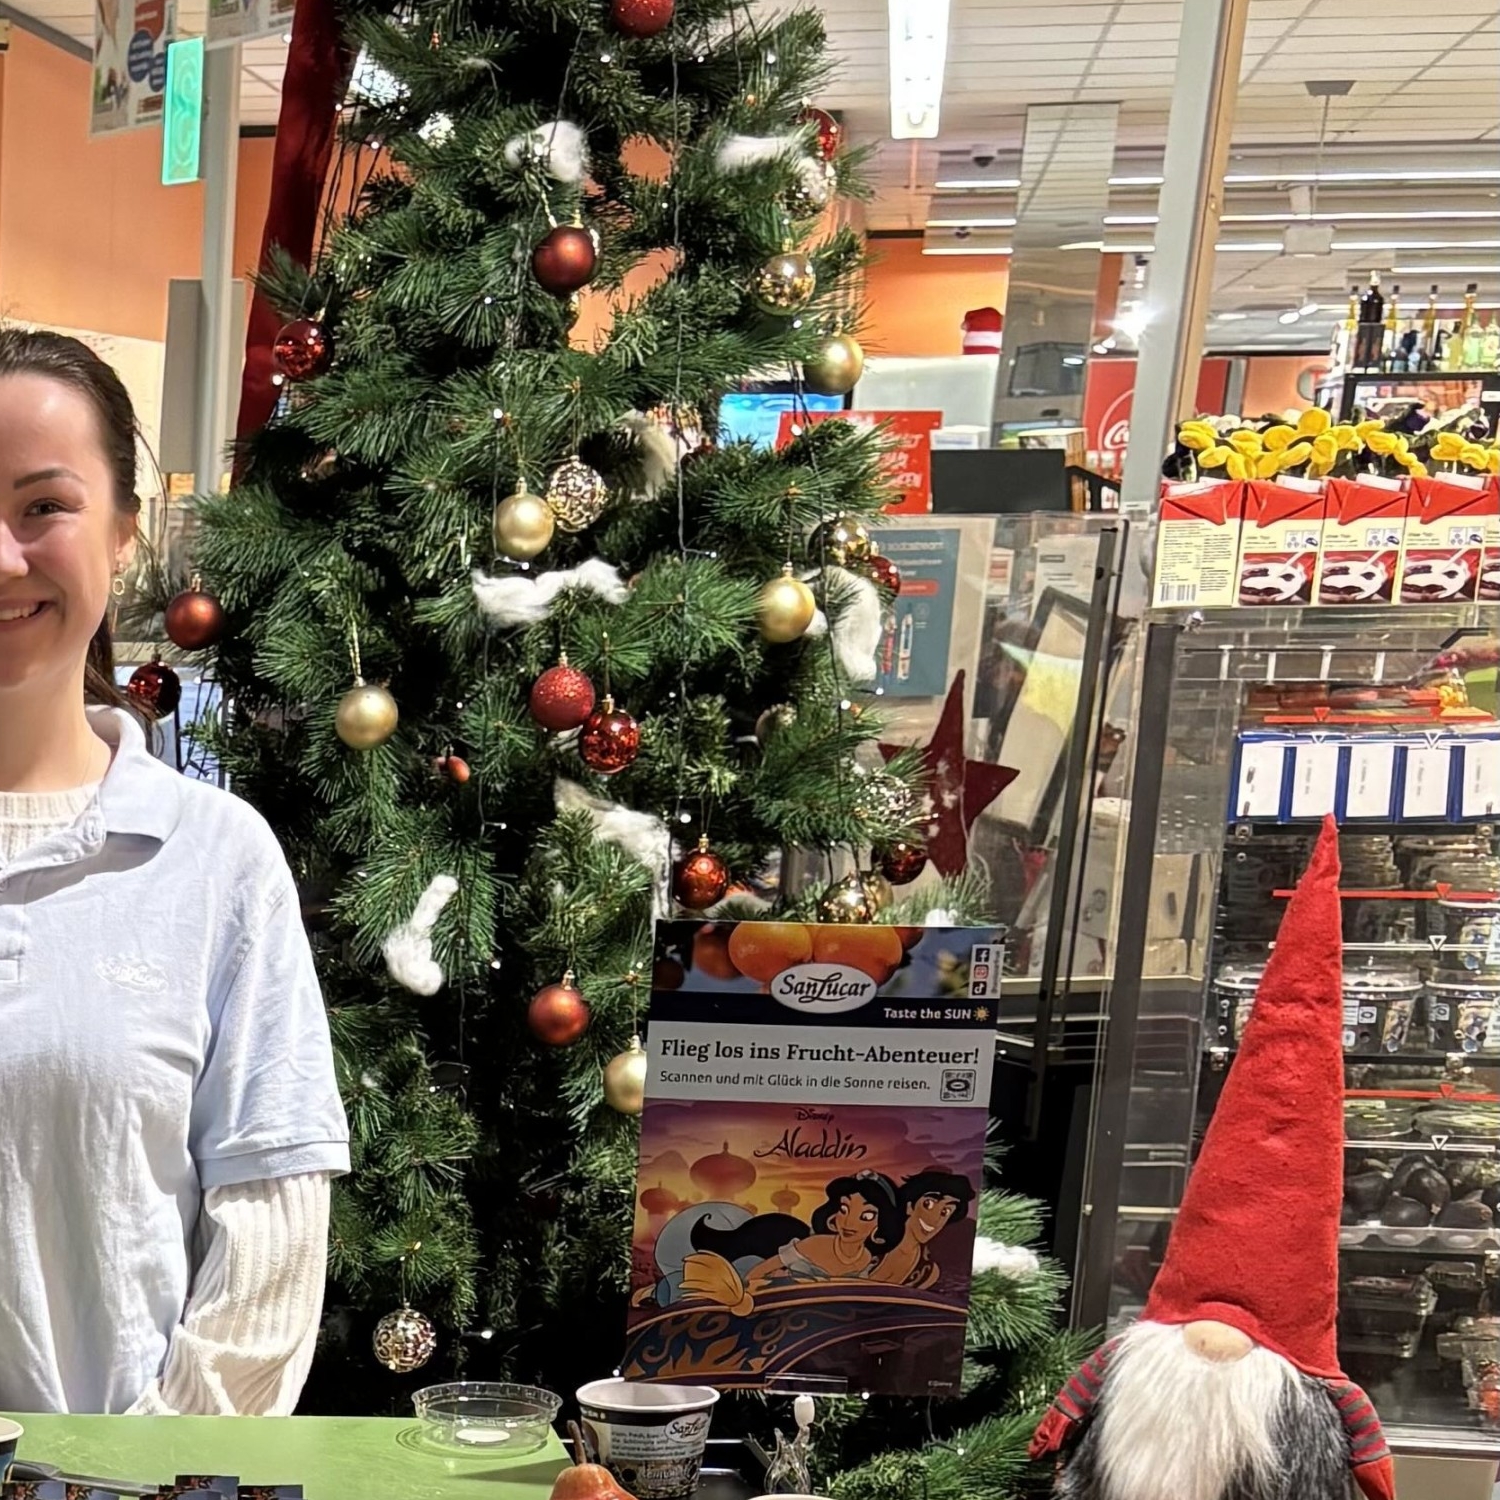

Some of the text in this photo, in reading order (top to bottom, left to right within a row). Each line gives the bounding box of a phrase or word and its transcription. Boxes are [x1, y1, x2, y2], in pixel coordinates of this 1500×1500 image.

[779, 972, 872, 1003] SanLucar
[884, 1008, 972, 1020] Taste the SUN
[661, 1039, 979, 1064] Flieg los ins Frucht-Abenteuer!
[660, 1071, 930, 1090] Scannen und mit Glück in die Sonne reisen.
[792, 1108, 835, 1124] Disney
[754, 1127, 867, 1159] Aladdin
